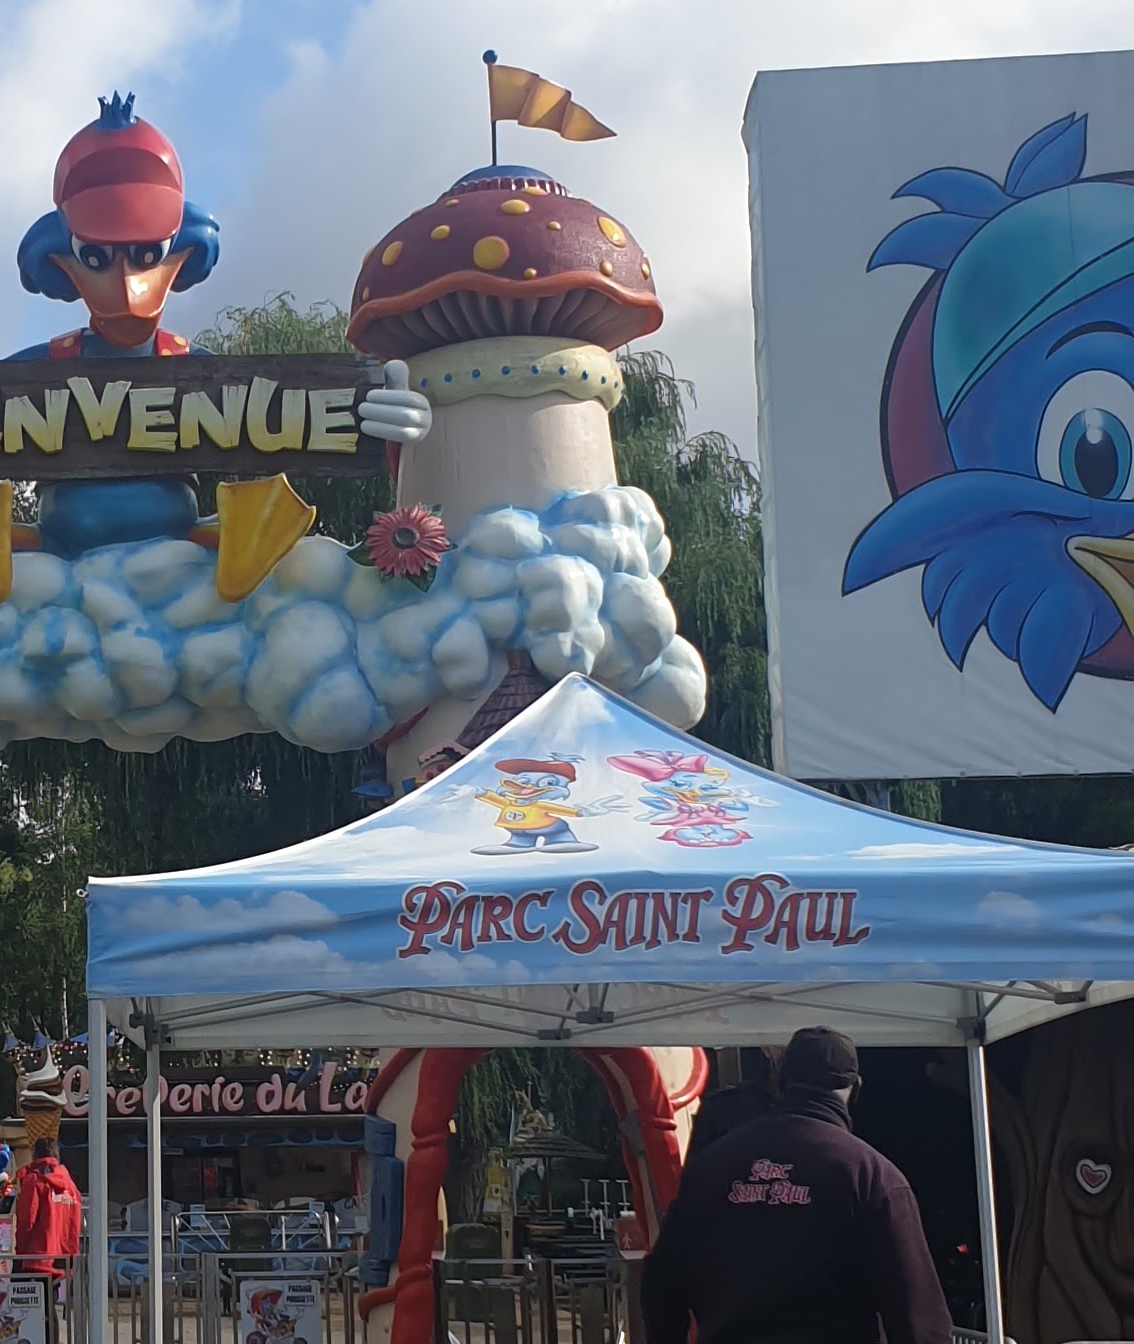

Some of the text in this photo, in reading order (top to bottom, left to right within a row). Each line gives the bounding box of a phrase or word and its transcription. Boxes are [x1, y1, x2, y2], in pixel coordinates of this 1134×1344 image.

[398, 873, 871, 959] PARC SAINT PAUL
[256, 1073, 307, 1113] du
